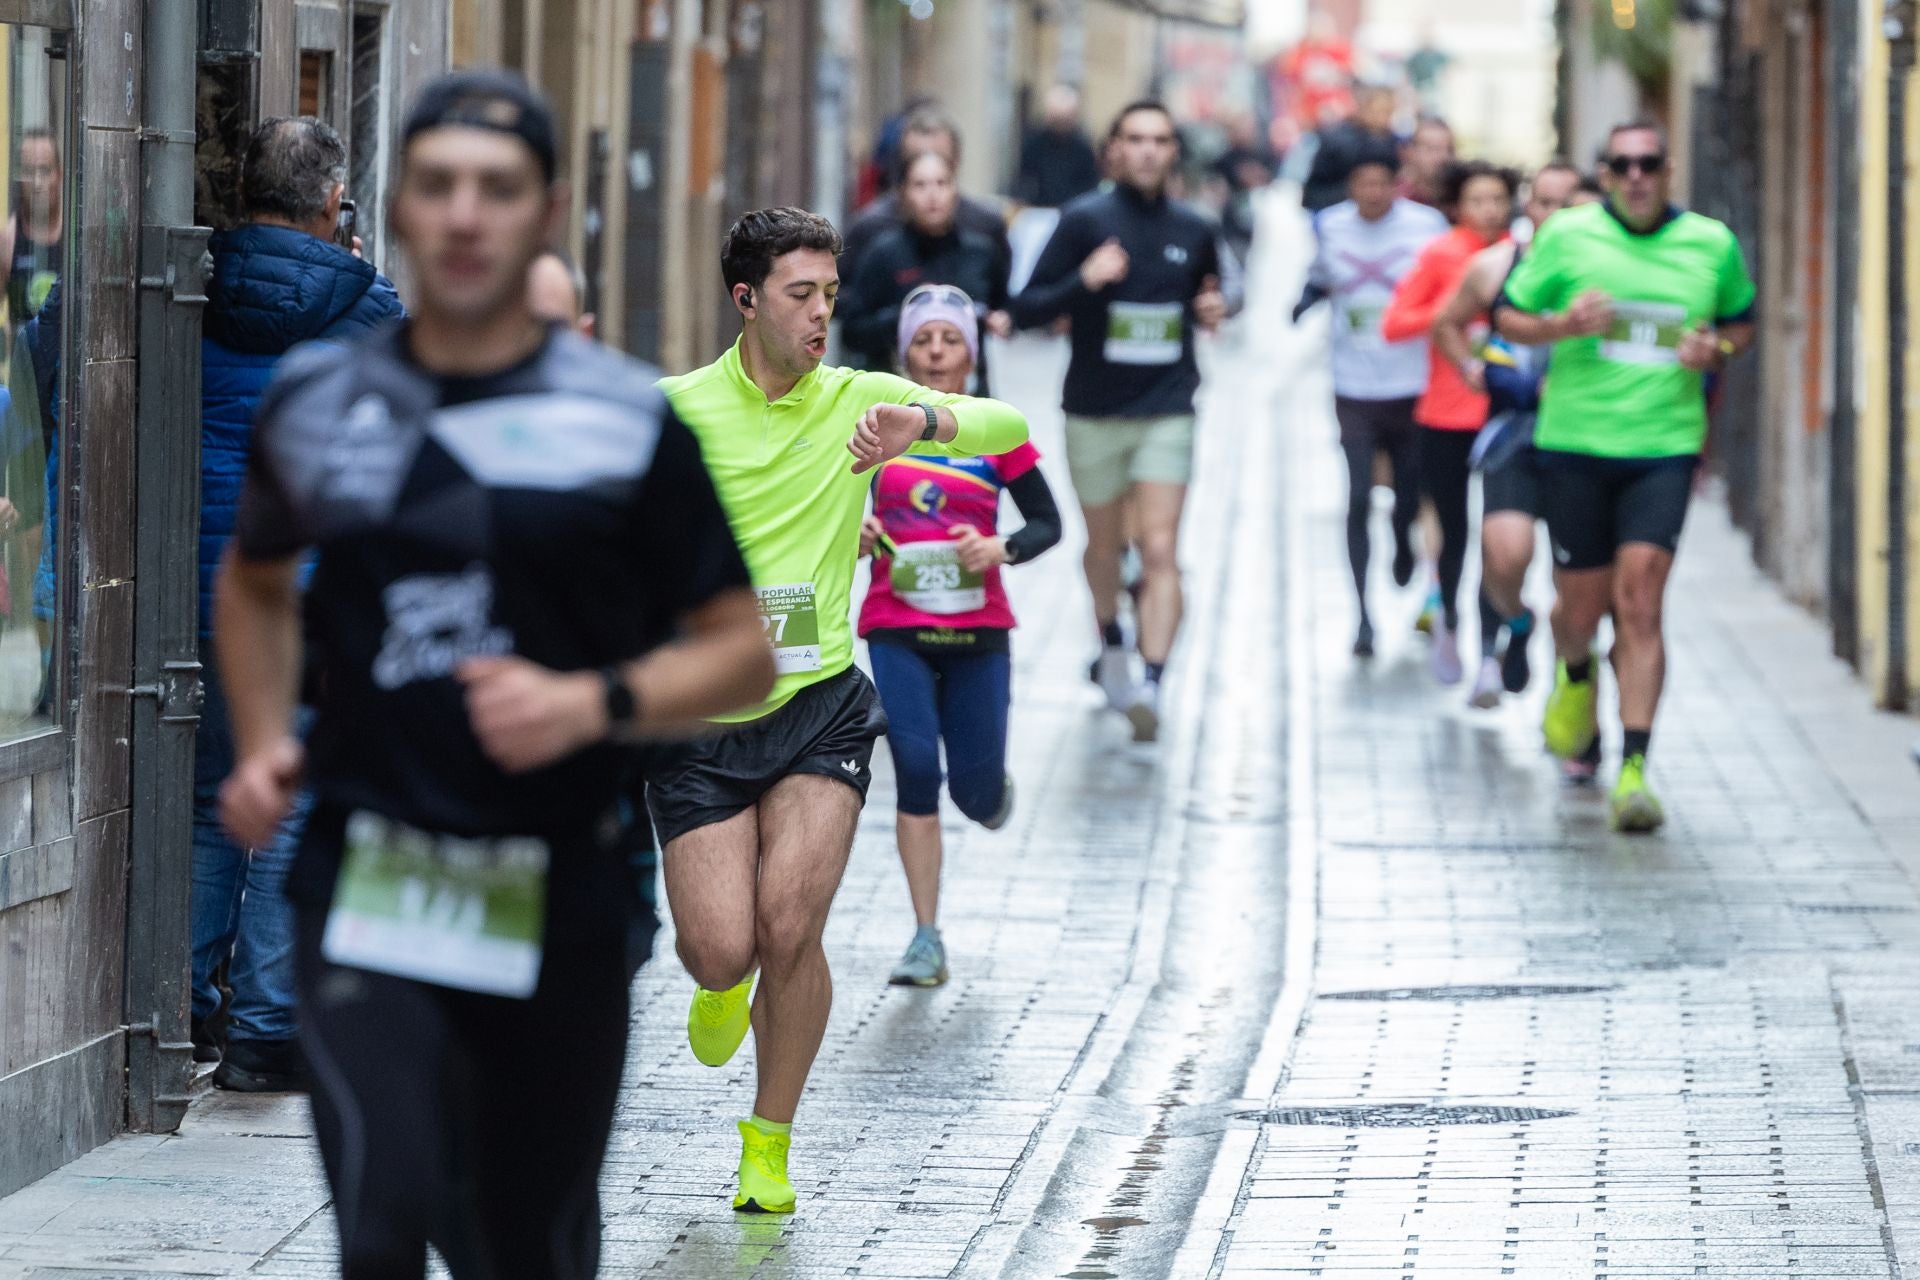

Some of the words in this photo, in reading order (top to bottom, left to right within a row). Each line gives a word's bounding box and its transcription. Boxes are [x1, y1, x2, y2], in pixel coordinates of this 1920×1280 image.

[914, 565, 960, 590] 253
[762, 586, 812, 597] POPULAR
[766, 596, 811, 606] ESPERANZA
